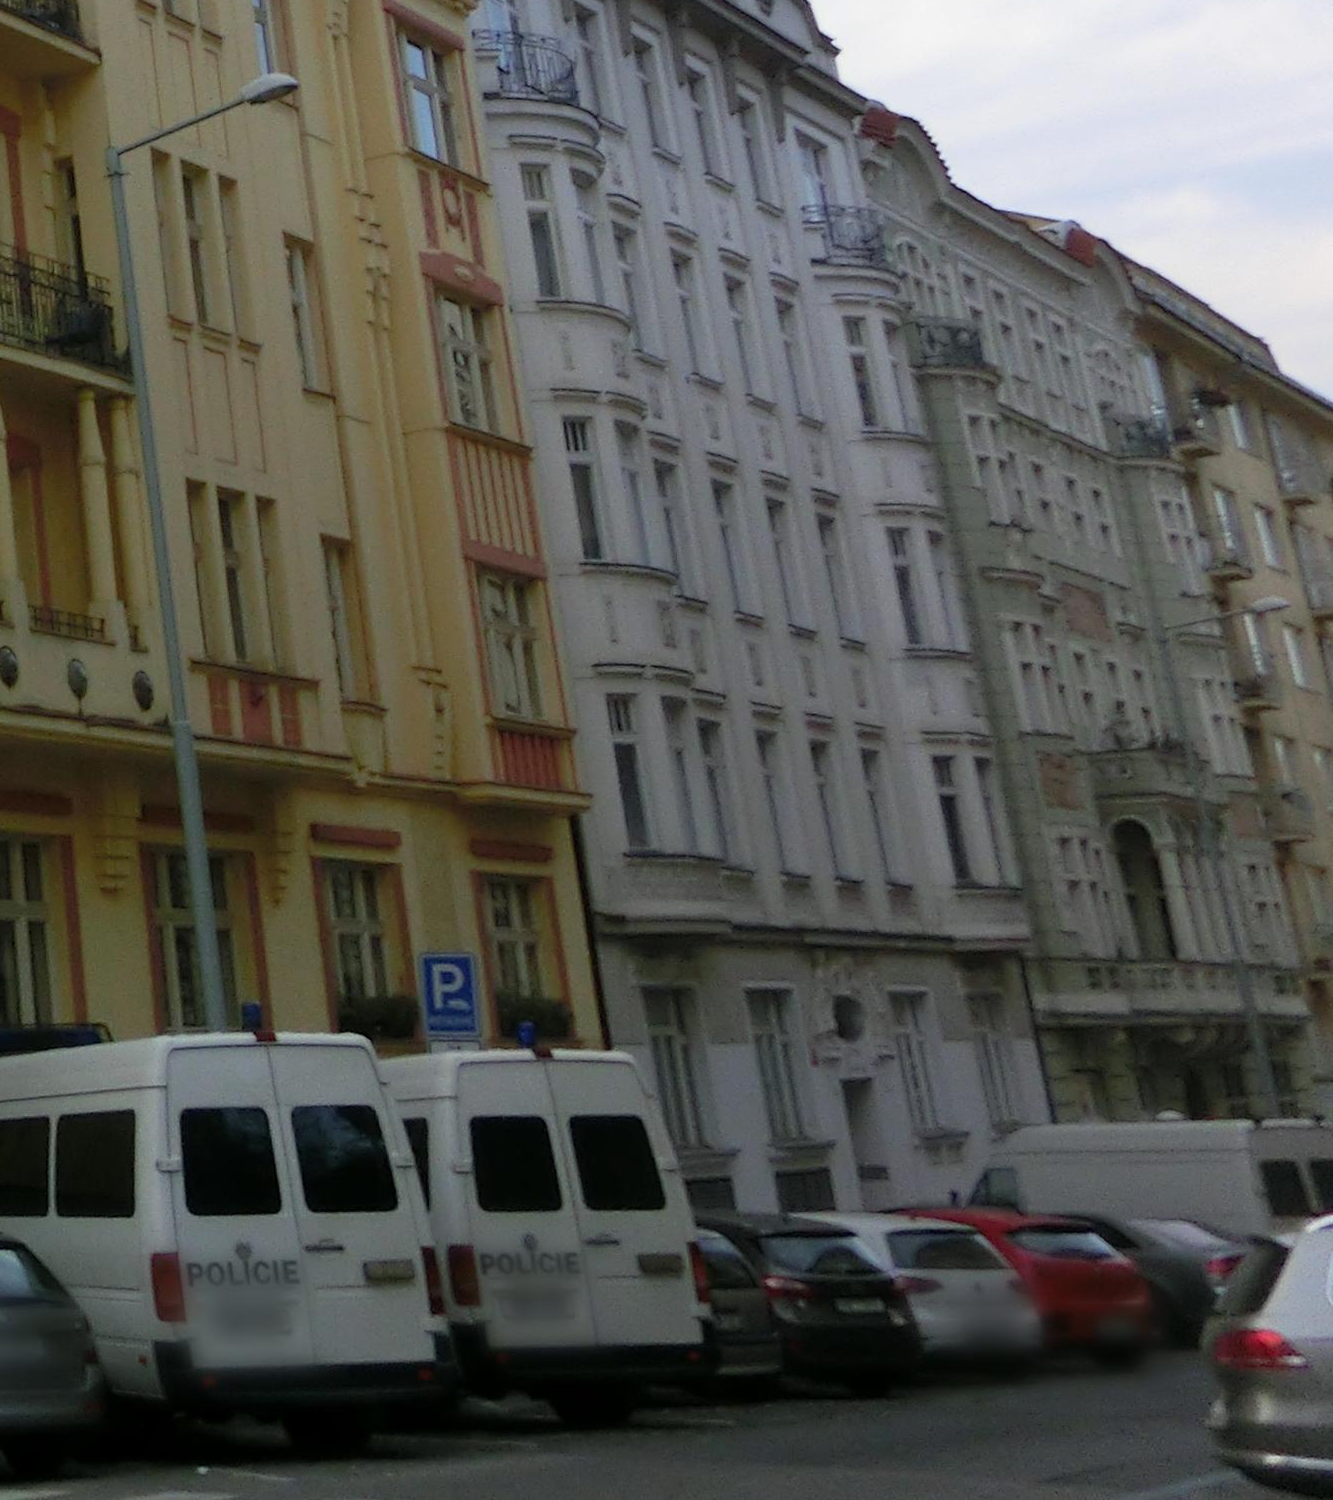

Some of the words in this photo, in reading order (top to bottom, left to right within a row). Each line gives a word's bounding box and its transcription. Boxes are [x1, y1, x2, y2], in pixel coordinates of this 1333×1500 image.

[432, 963, 465, 1009] P
[186, 1259, 301, 1287] POLICIE
[479, 1251, 582, 1276] POLICIE
